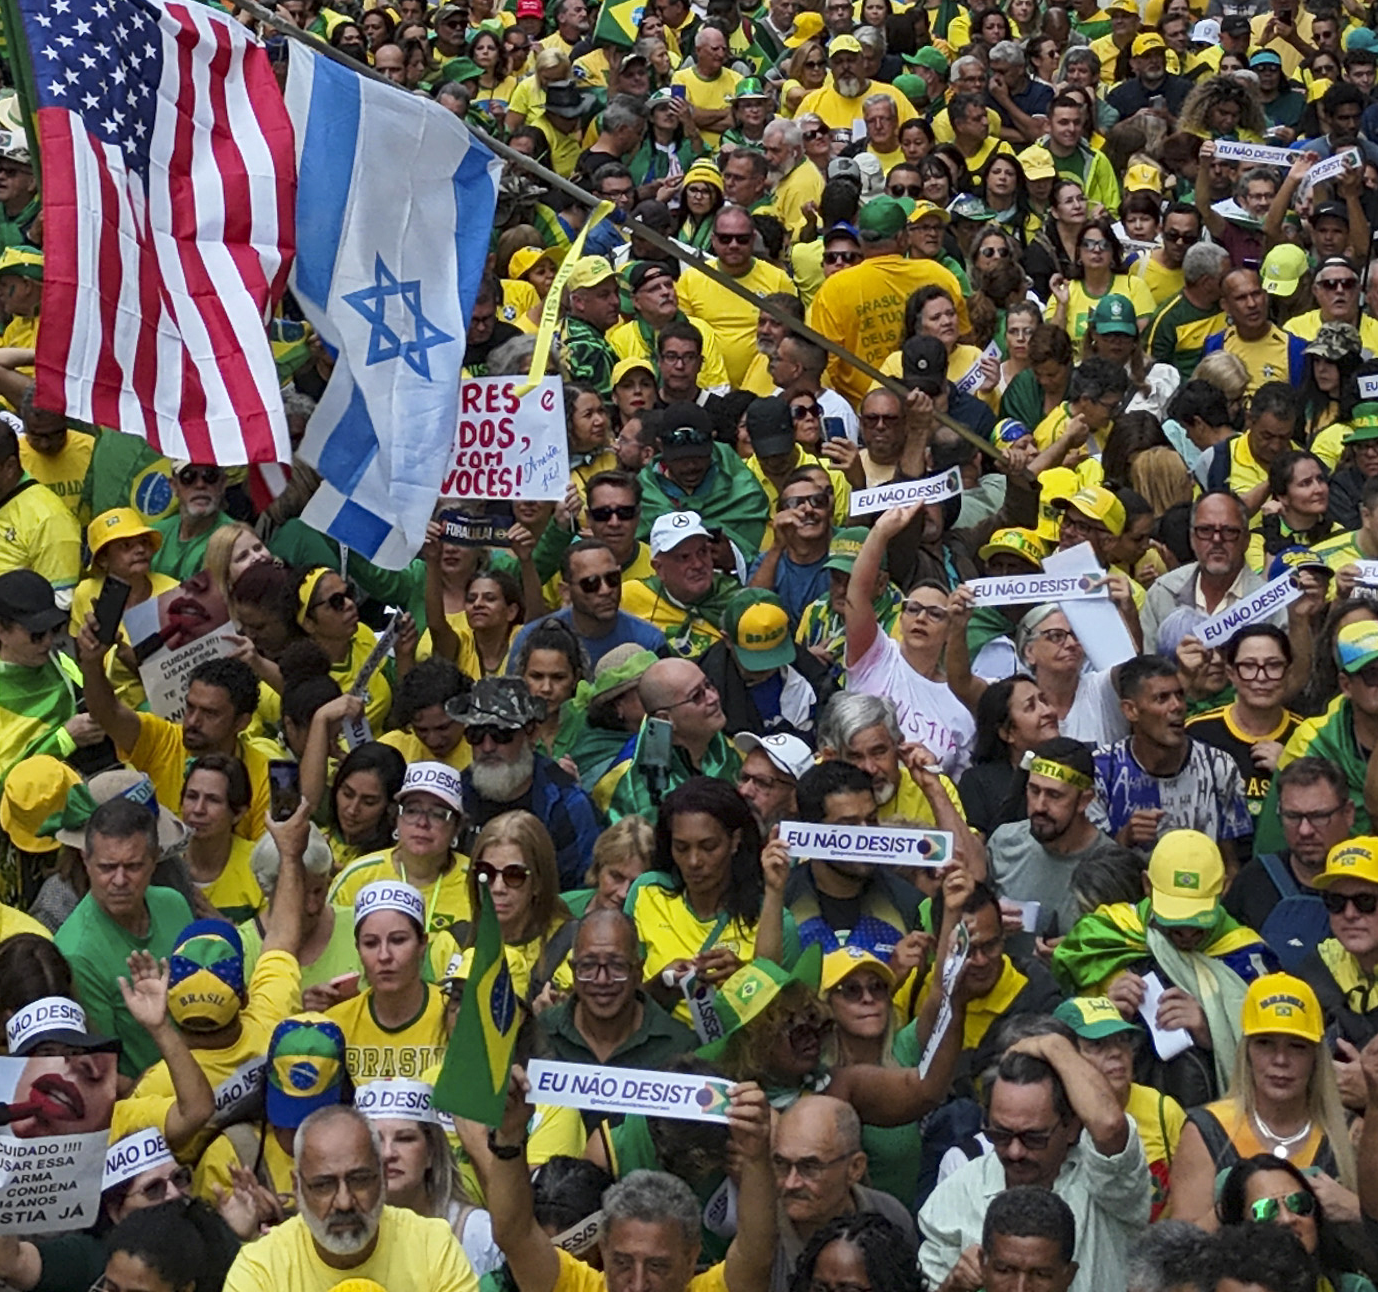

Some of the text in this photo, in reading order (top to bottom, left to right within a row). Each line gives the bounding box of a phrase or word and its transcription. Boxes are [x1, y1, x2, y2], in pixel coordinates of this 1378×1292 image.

[858, 495, 876, 508] EU
[877, 487, 906, 504] NÃO
[973, 585, 993, 598] EU
[995, 580, 1028, 595] NÃO
[1204, 625, 1222, 641] EU
[1222, 604, 1251, 632] NÃO
[164, 648, 218, 680] USAR ESSA
[787, 831, 810, 847] EU
[813, 830, 851, 849] NÃO
[180, 991, 226, 1007] BRASIL
[538, 1072, 567, 1093] EU
[570, 1072, 617, 1095] NÃO
[64, 1142, 82, 1153] !!!!
[37, 1157, 74, 1170] ESSA
[104, 1145, 140, 1175] NÃO
[11, 1172, 53, 1184] ARMA
[7, 1181, 78, 1197] CONDENA
[0, 1196, 57, 1208] 14 ANOS
[58, 1204, 84, 1219] JÁ
